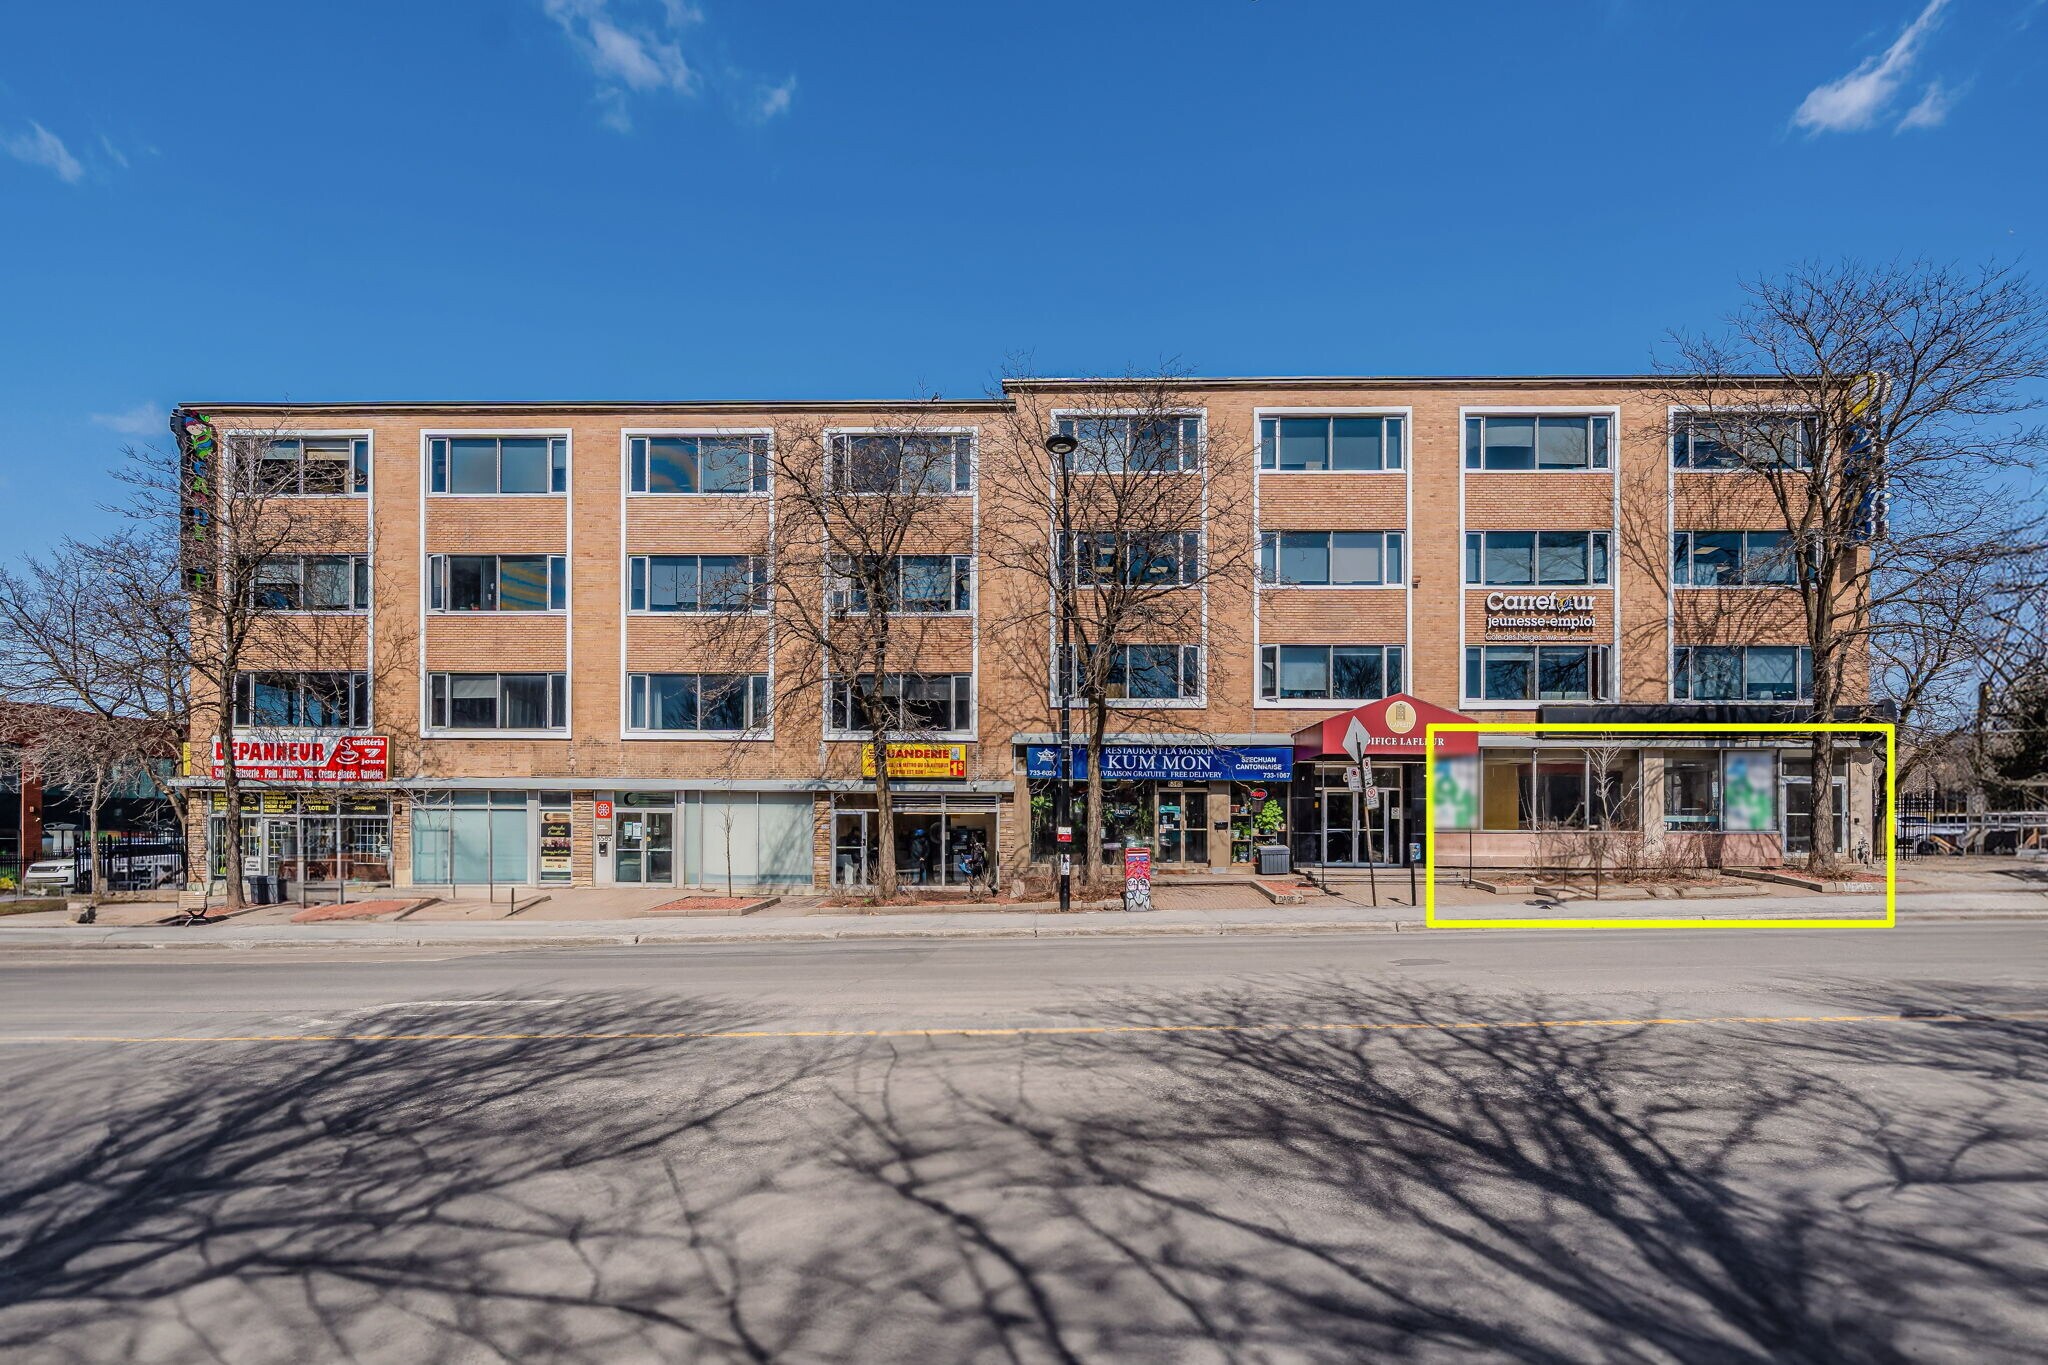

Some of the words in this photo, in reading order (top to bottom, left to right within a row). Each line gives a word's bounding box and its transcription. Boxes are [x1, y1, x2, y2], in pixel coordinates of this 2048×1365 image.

[1488, 614, 1596, 629] jeunesse-emploi
[1400, 737, 1444, 746] LAFLUR
[364, 748, 381, 758] 7
[887, 749, 949, 758] UANDERIE
[1105, 747, 1162, 755] RESTAURANT
[1165, 747, 1177, 755] LA
[1179, 747, 1214, 755] MAISON
[361, 758, 385, 766] jours
[1107, 755, 1157, 770] KUM
[1162, 755, 1213, 770] MON
[1100, 770, 1134, 778] IVRAISON
[1133, 770, 1167, 778] GRATUITE
